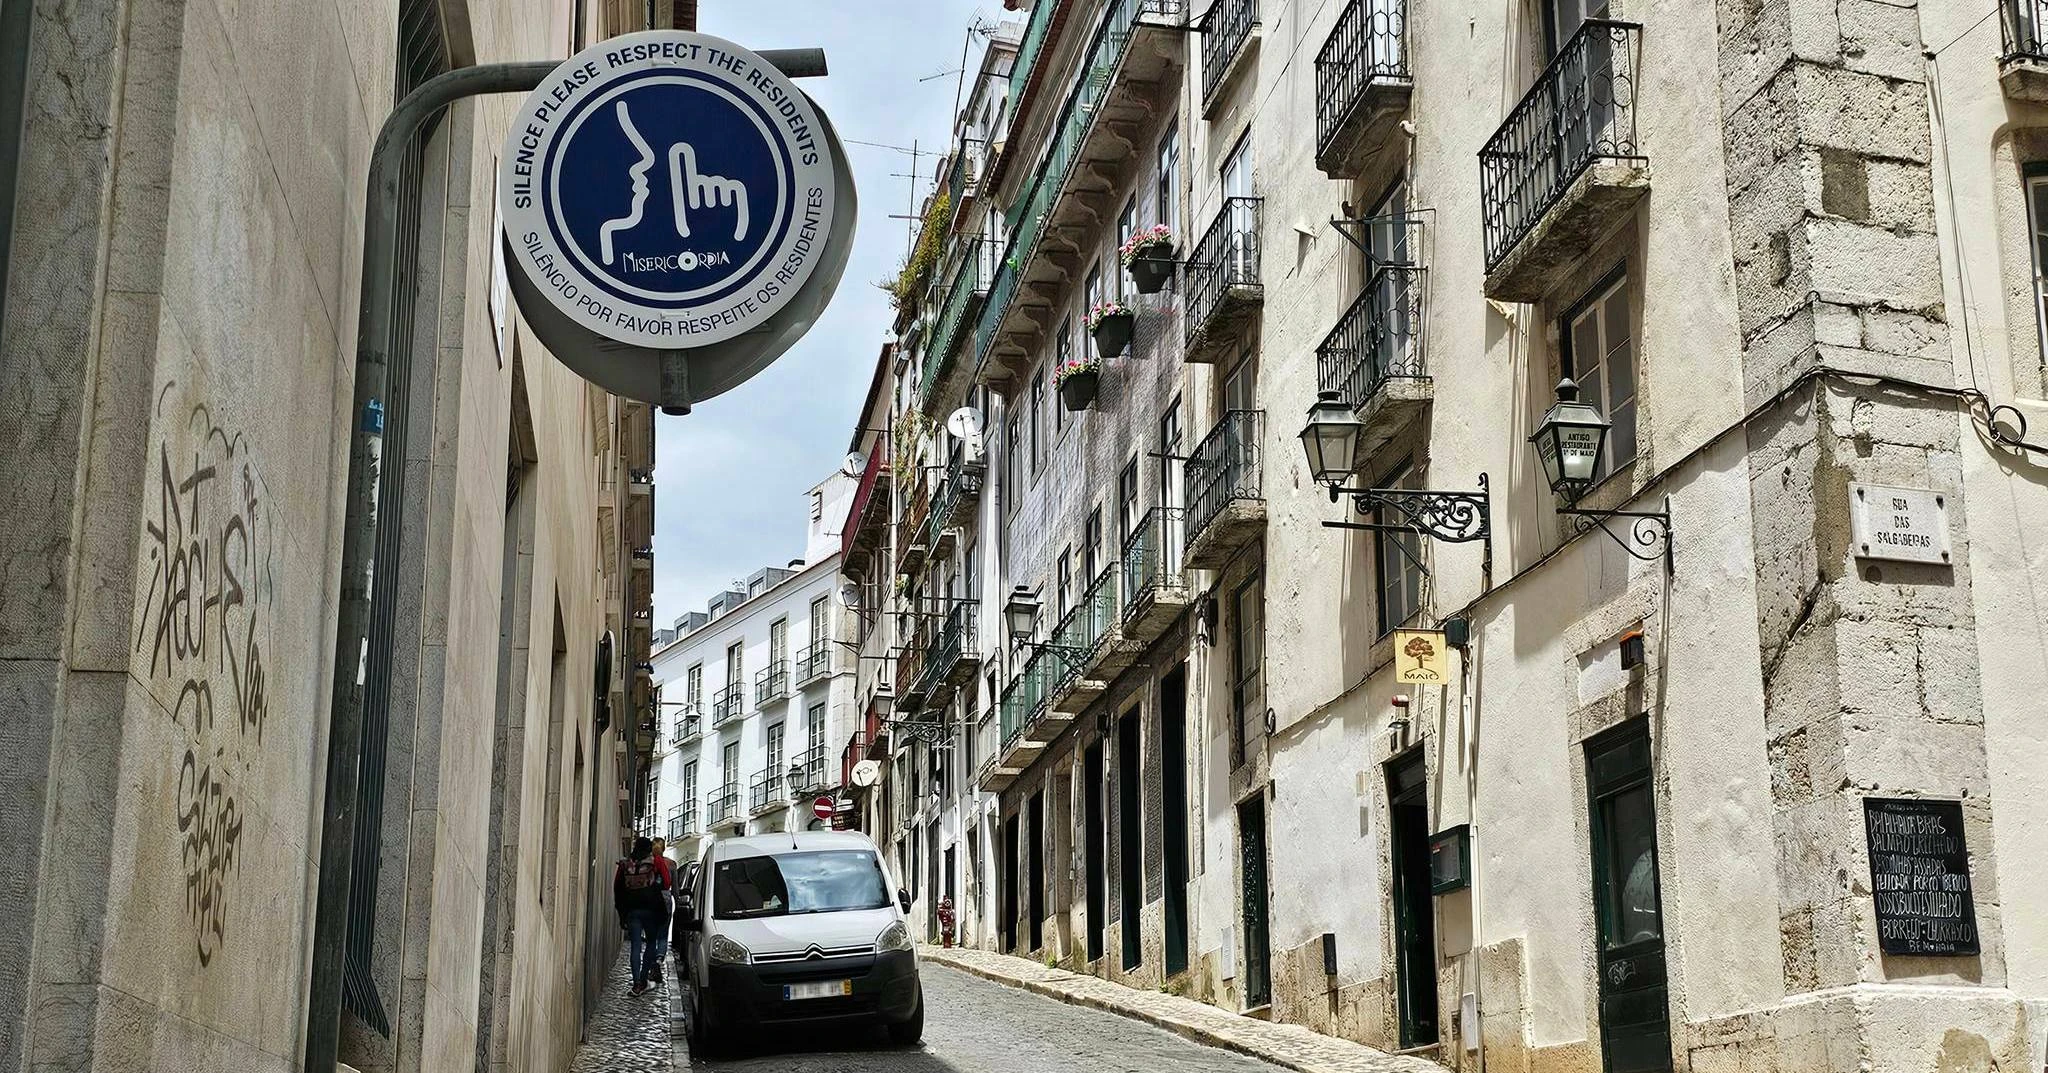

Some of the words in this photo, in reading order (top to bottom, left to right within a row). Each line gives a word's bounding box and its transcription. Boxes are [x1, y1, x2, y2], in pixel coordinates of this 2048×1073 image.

[514, 123, 545, 209] SILENCE
[538, 61, 600, 124] PLEASE
[606, 42, 702, 69] RESPECT
[707, 48, 747, 76] THE
[745, 71, 819, 167] RESIDENTS
[523, 230, 579, 299] SILÊNCIO
[575, 293, 613, 323] POR
[615, 313, 672, 336] FAVOR
[677, 301, 758, 336] RESPEITE
[756, 281, 781, 305] OS
[777, 186, 823, 286] RESIDENTES
[1568, 433, 1590, 441] ANTIGO
[1892, 497, 1908, 511] RUA
[1894, 515, 1910, 529] DAS
[1877, 531, 1931, 548] SALGADEIRAS
[1404, 672, 1439, 680] MAIO
[1914, 857, 1947, 876] ASSADAS
